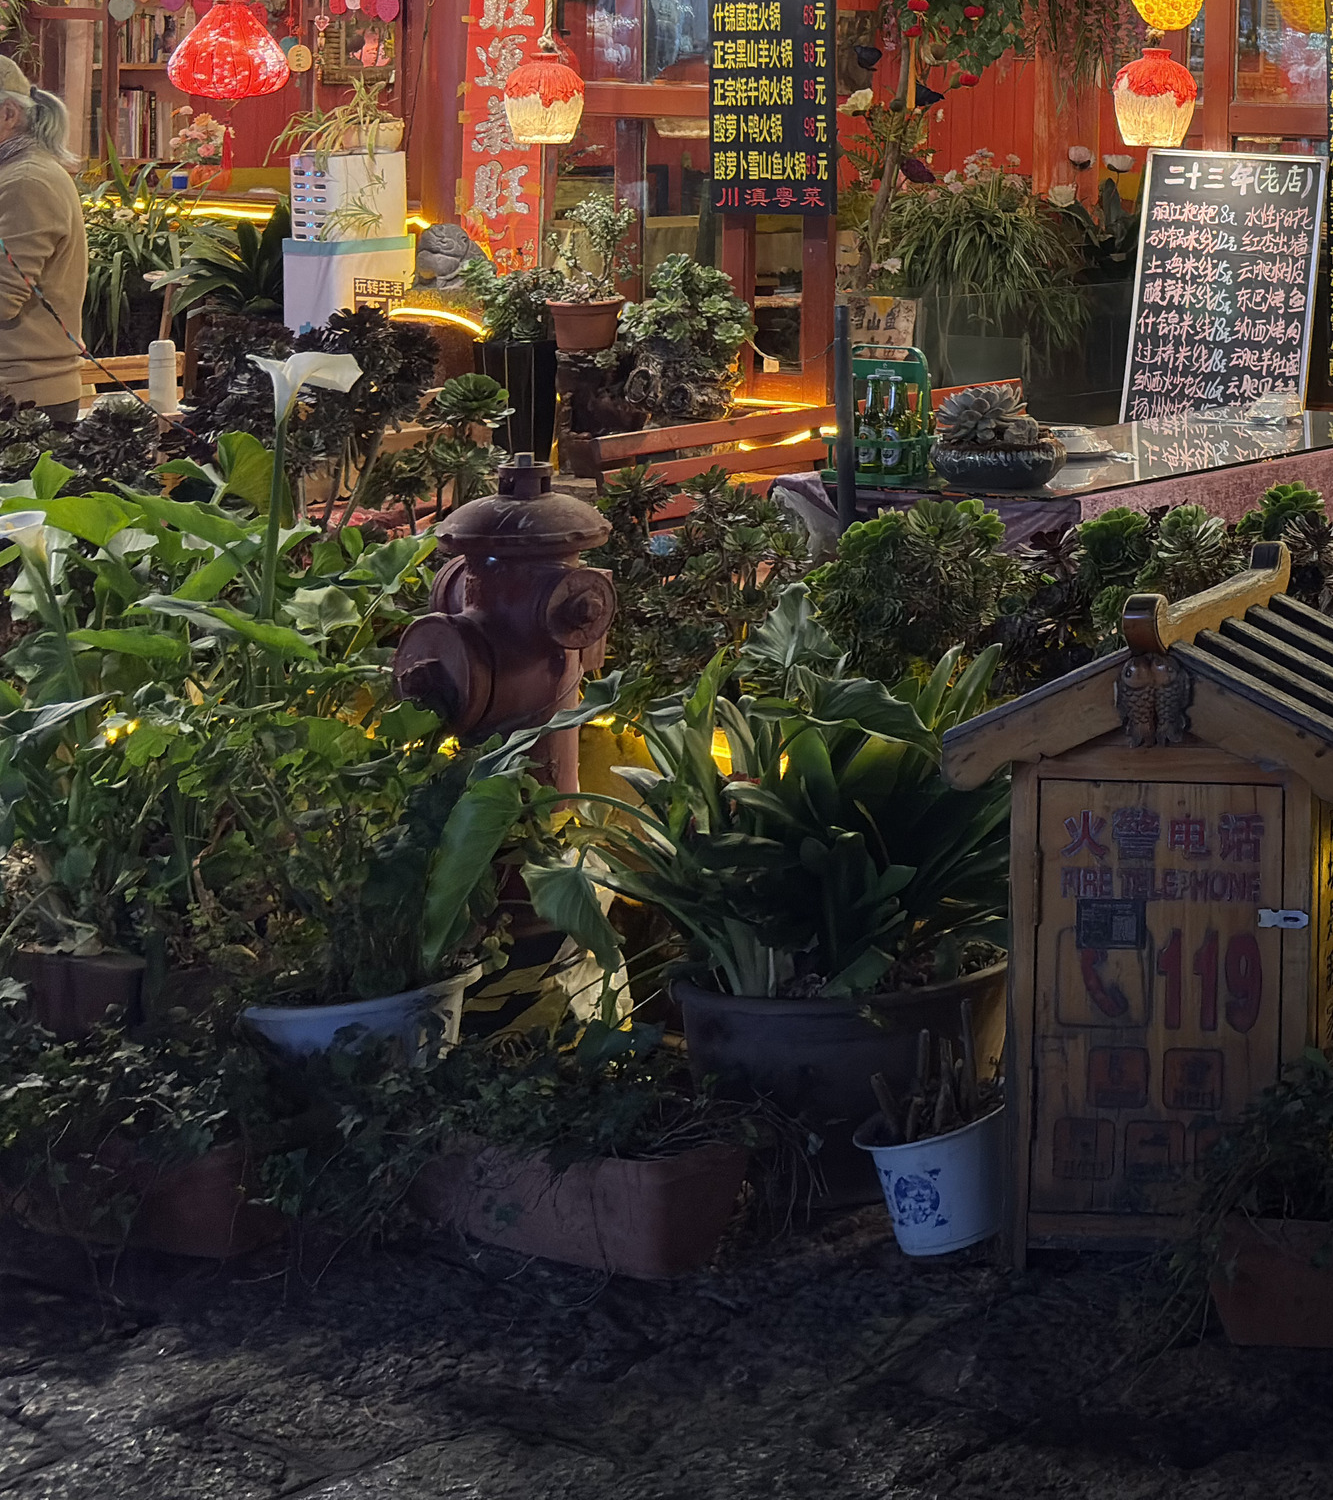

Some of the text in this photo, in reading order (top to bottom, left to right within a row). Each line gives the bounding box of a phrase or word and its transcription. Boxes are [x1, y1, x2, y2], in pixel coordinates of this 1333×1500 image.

[713, 2, 781, 31] 什锦菌菇火锅
[713, 39, 826, 69] 正宗黑山羊火锅 98元
[713, 76, 827, 106] 正宗牦牛肉火锅 98元
[714, 114, 783, 143] 酸萝卜鸭火锅
[715, 187, 825, 208] 川滇粤菜
[355, 279, 403, 296] 玩转生活
[1158, 928, 1263, 1033] 119
